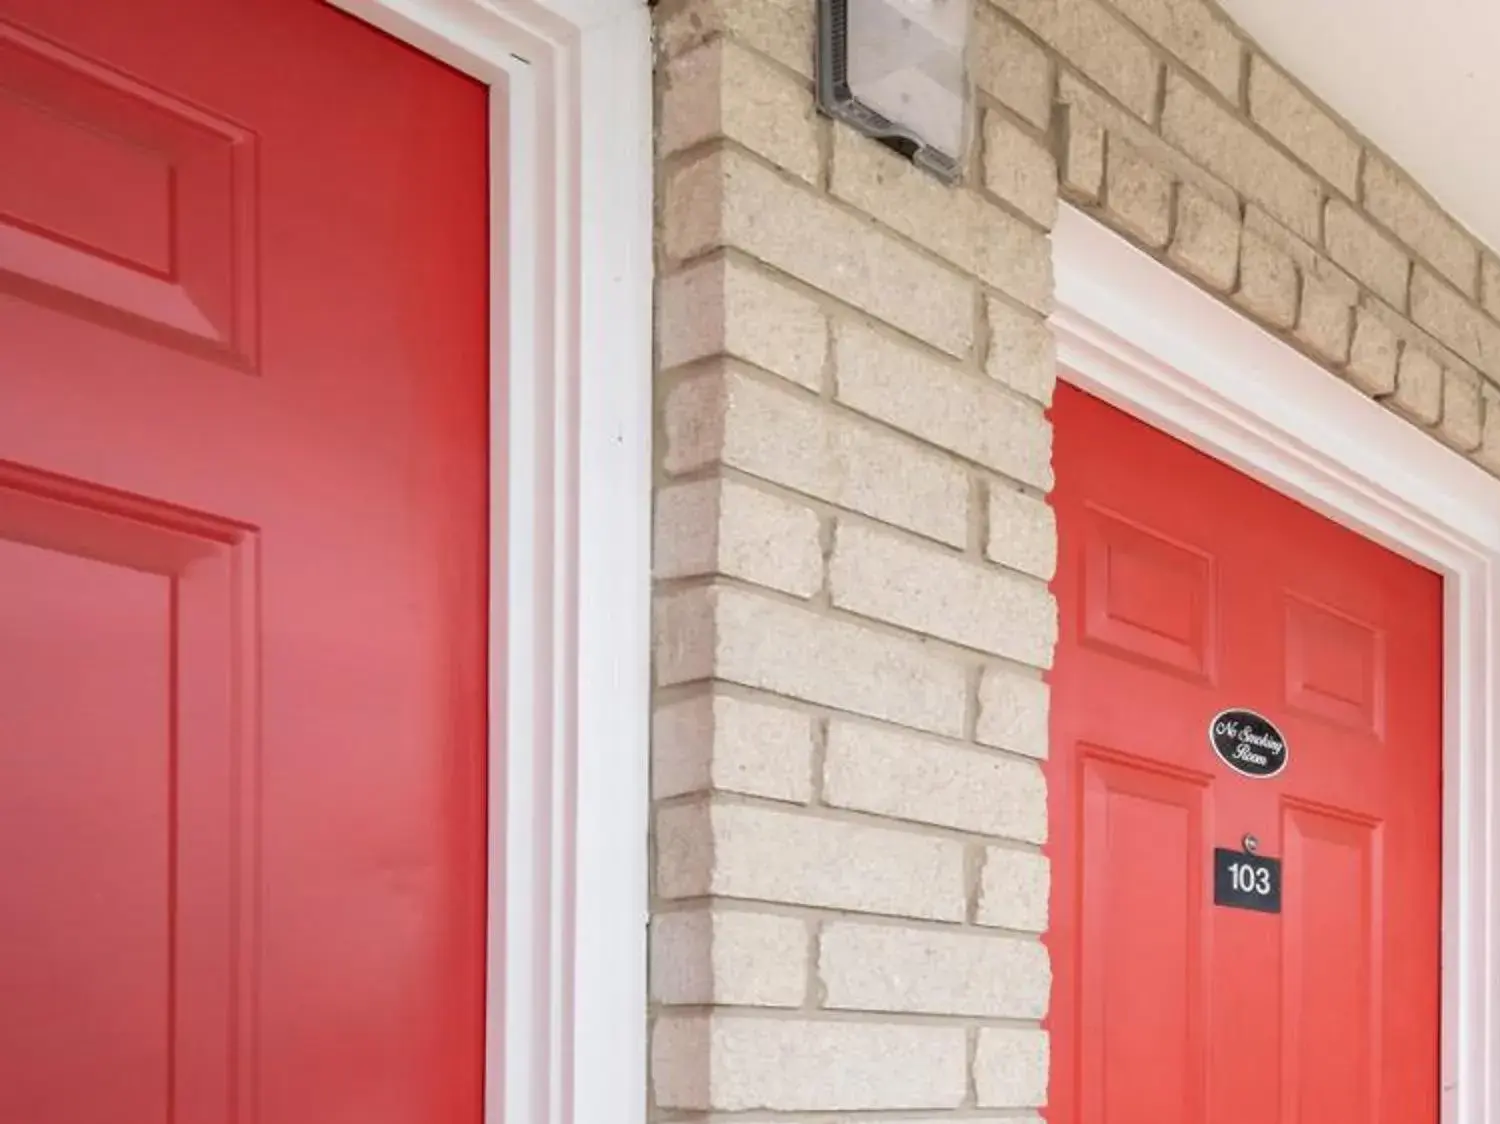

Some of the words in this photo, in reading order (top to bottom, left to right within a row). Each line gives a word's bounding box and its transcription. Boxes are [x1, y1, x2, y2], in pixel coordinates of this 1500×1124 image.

[1216, 721, 1237, 739] No
[1238, 726, 1283, 755] Smoking
[1232, 743, 1268, 767] Room
[1228, 864, 1271, 895] 103
